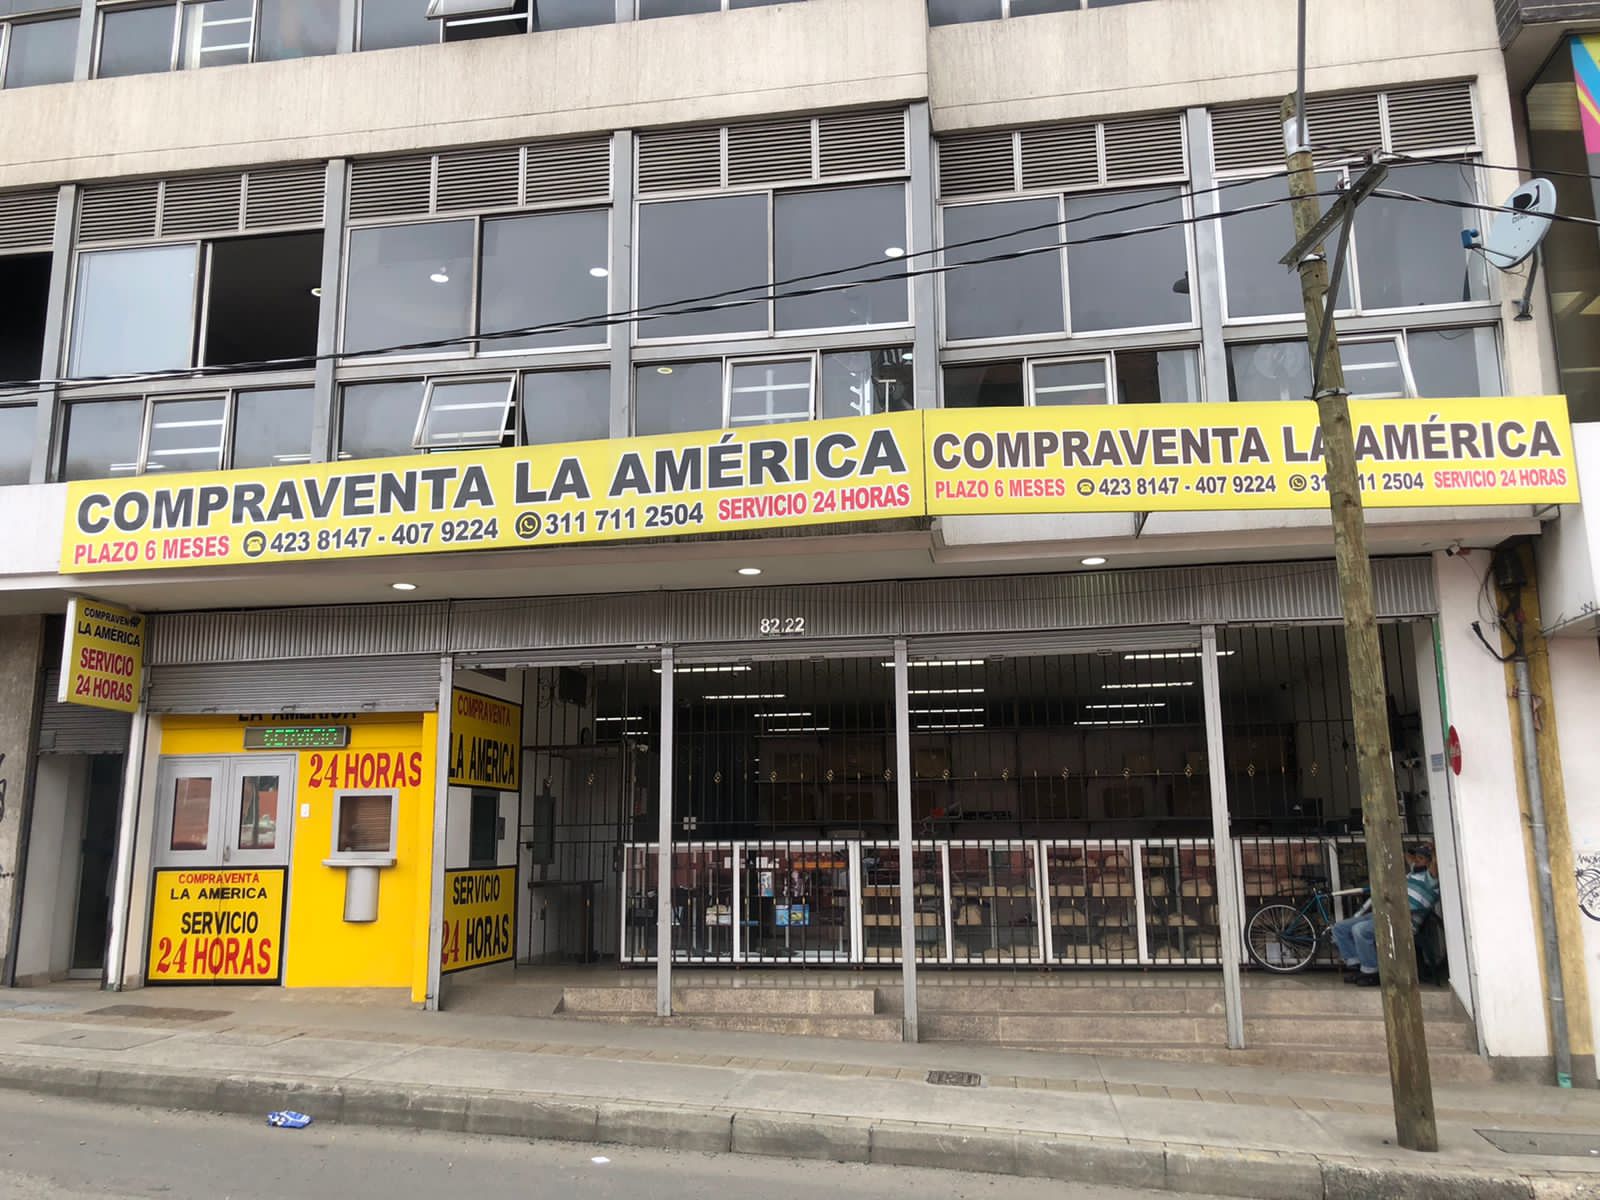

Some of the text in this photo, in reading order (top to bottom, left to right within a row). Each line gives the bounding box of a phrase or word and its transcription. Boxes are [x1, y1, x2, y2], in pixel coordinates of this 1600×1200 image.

[934, 427, 1270, 470] COMPRAVENTA
[1355, 414, 1561, 461] AMÉRICA
[77, 430, 906, 534] COMPRAVENTA LA AMÉRICA
[936, 480, 989, 498] PLAZO
[994, 480, 1004, 497] 6
[1009, 479, 1065, 498] MESES
[1099, 478, 1131, 495] 423
[1137, 477, 1179, 494] 8147
[1195, 476, 1227, 493] 407
[1233, 475, 1276, 493] 9224
[1382, 472, 1424, 490] 2504
[1434, 470, 1496, 488] SERVICIO
[1500, 469, 1516, 487] 24
[1520, 468, 1567, 486] HORAS
[74, 542, 139, 565] PLAZO
[144, 540, 156, 561] 6
[162, 535, 230, 559] MESES
[270, 531, 310, 554] 423
[316, 527, 371, 551] 8147
[391, 522, 434, 546] 407
[440, 518, 498, 542] 9224
[546, 512, 585, 535] 311
[595, 508, 636, 531] 711
[646, 503, 703, 528] 2504
[718, 492, 807, 521] SERVICIO
[812, 489, 836, 512] 24
[841, 484, 910, 511] HORAS
[78, 621, 141, 648] LA AMERICA
[80, 647, 134, 677] SERVICIO
[76, 674, 133, 703] 24 HORAS
[457, 695, 511, 727] COMPRAVENTA
[308, 751, 423, 789] 24 HORAS
[449, 733, 515, 785] LA AMERICA
[170, 887, 268, 900] LA AMERICA
[178, 872, 260, 884] COMPRAVENTA
[453, 874, 501, 905] SERVICIO
[181, 911, 259, 935] SERVICIO
[465, 913, 509, 962] HORAS
[156, 936, 272, 975] 24 HORAS
